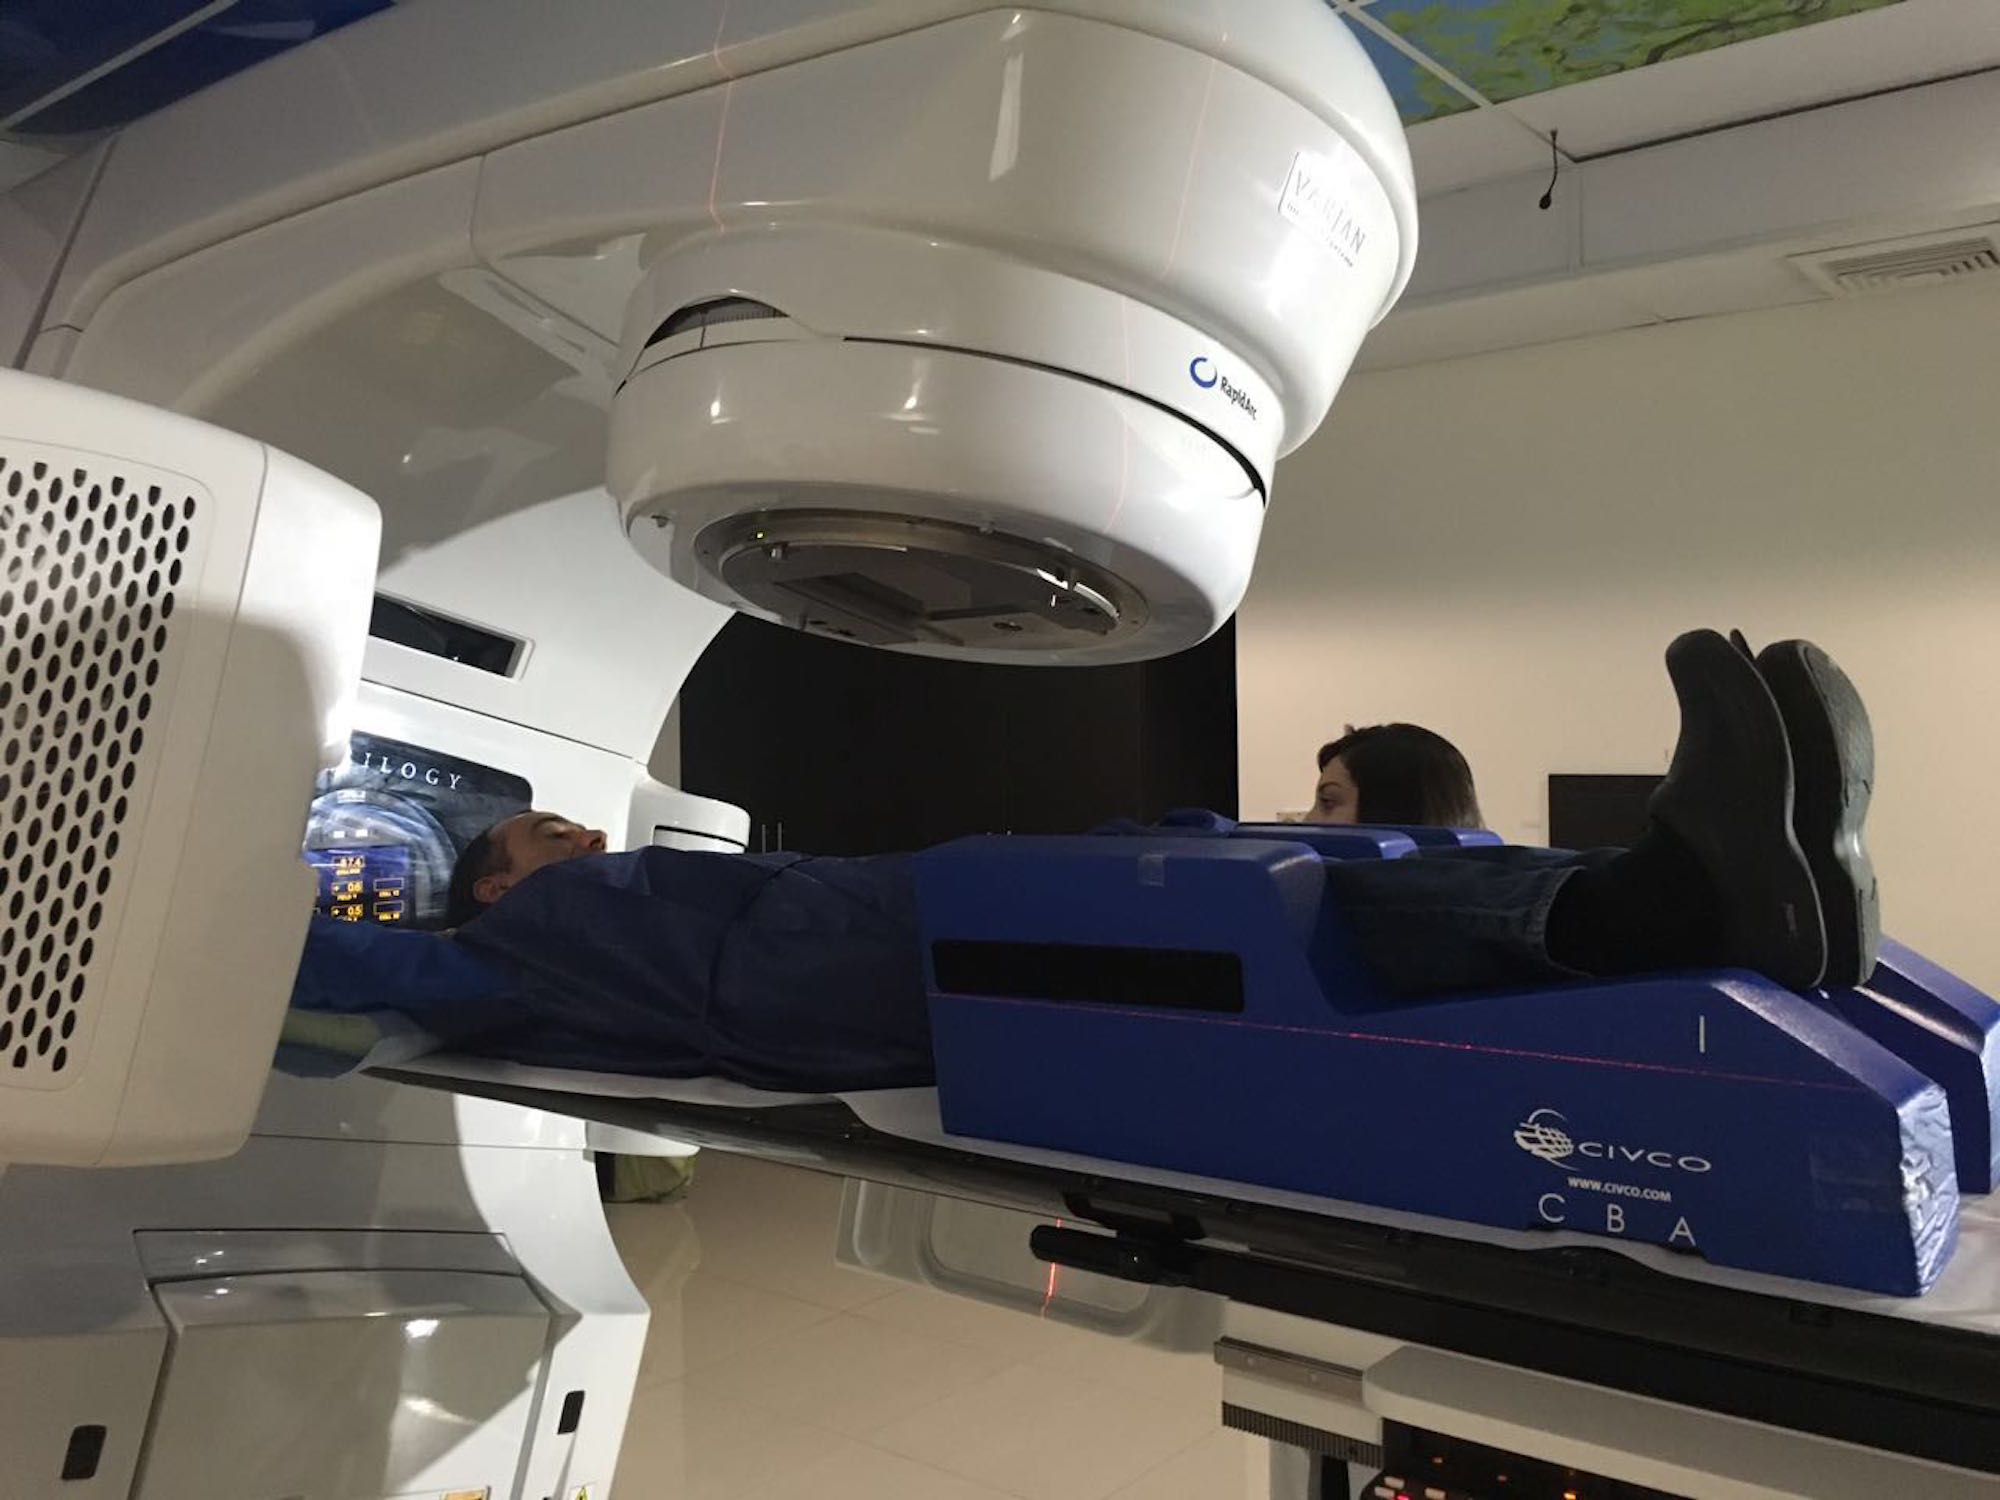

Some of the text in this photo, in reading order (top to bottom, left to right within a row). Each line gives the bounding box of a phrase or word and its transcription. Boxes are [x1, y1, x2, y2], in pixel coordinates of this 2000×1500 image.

[1220, 376, 1257, 420] RapidArc
[1578, 1141, 1712, 1172] CIVCO
[1538, 1193, 1697, 1247] C B A
